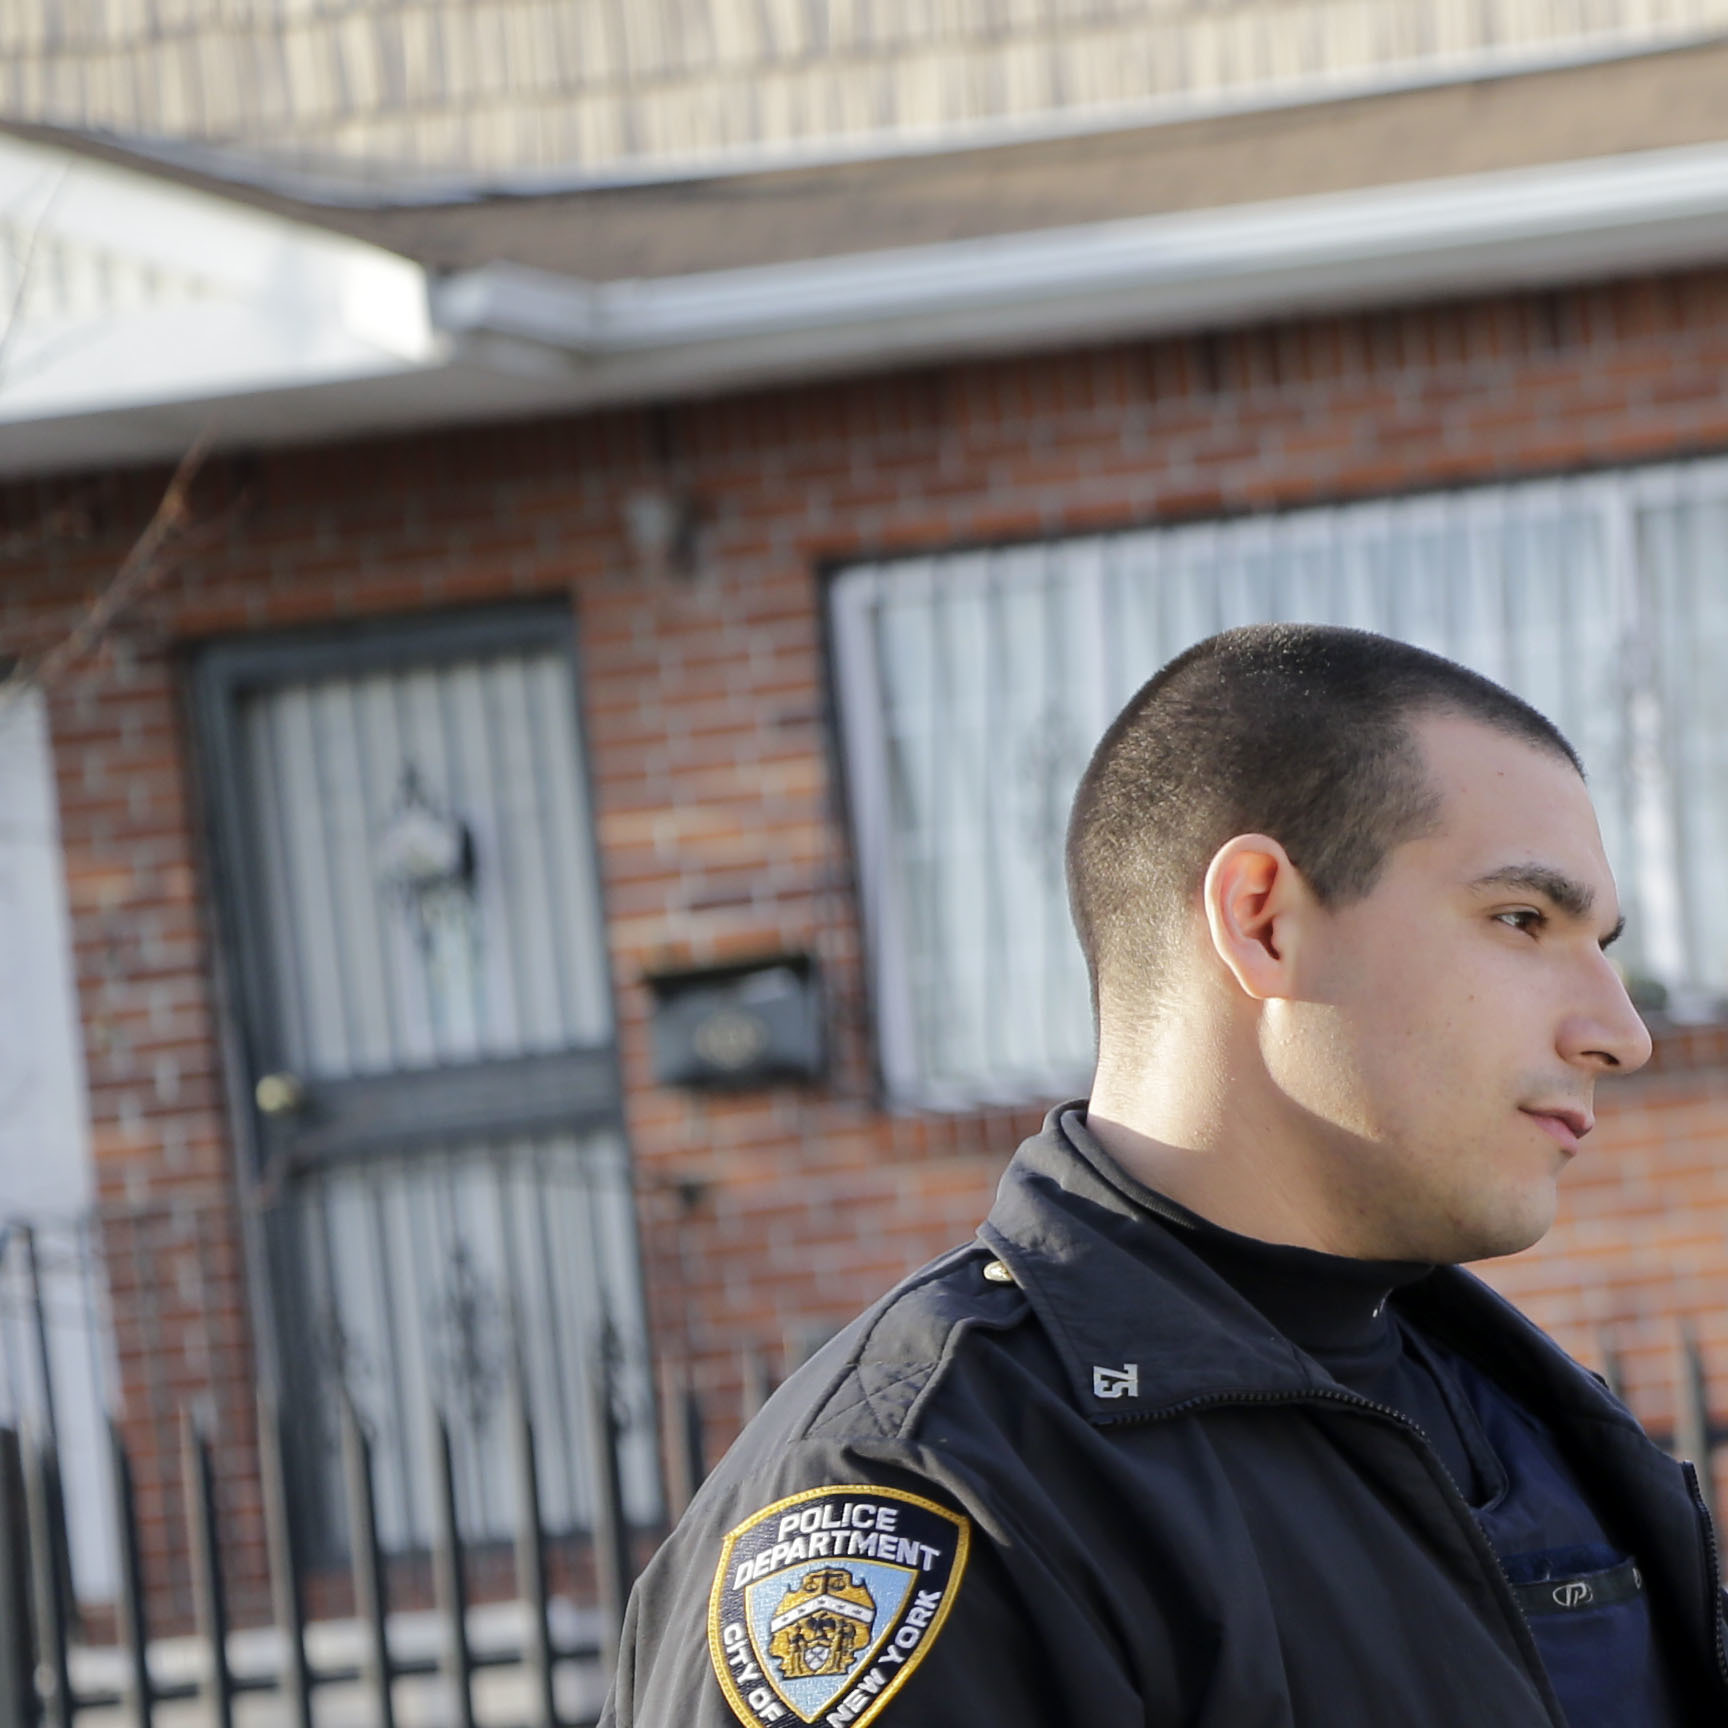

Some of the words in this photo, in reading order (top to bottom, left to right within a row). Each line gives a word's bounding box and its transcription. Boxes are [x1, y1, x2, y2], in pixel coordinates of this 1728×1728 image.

[777, 1503, 899, 1543] POLICE
[732, 1530, 941, 1591] DEPARTMENT
[877, 1589, 943, 1665] YORK
[723, 1622, 759, 1685] CITY
[748, 1689, 786, 1723] OF
